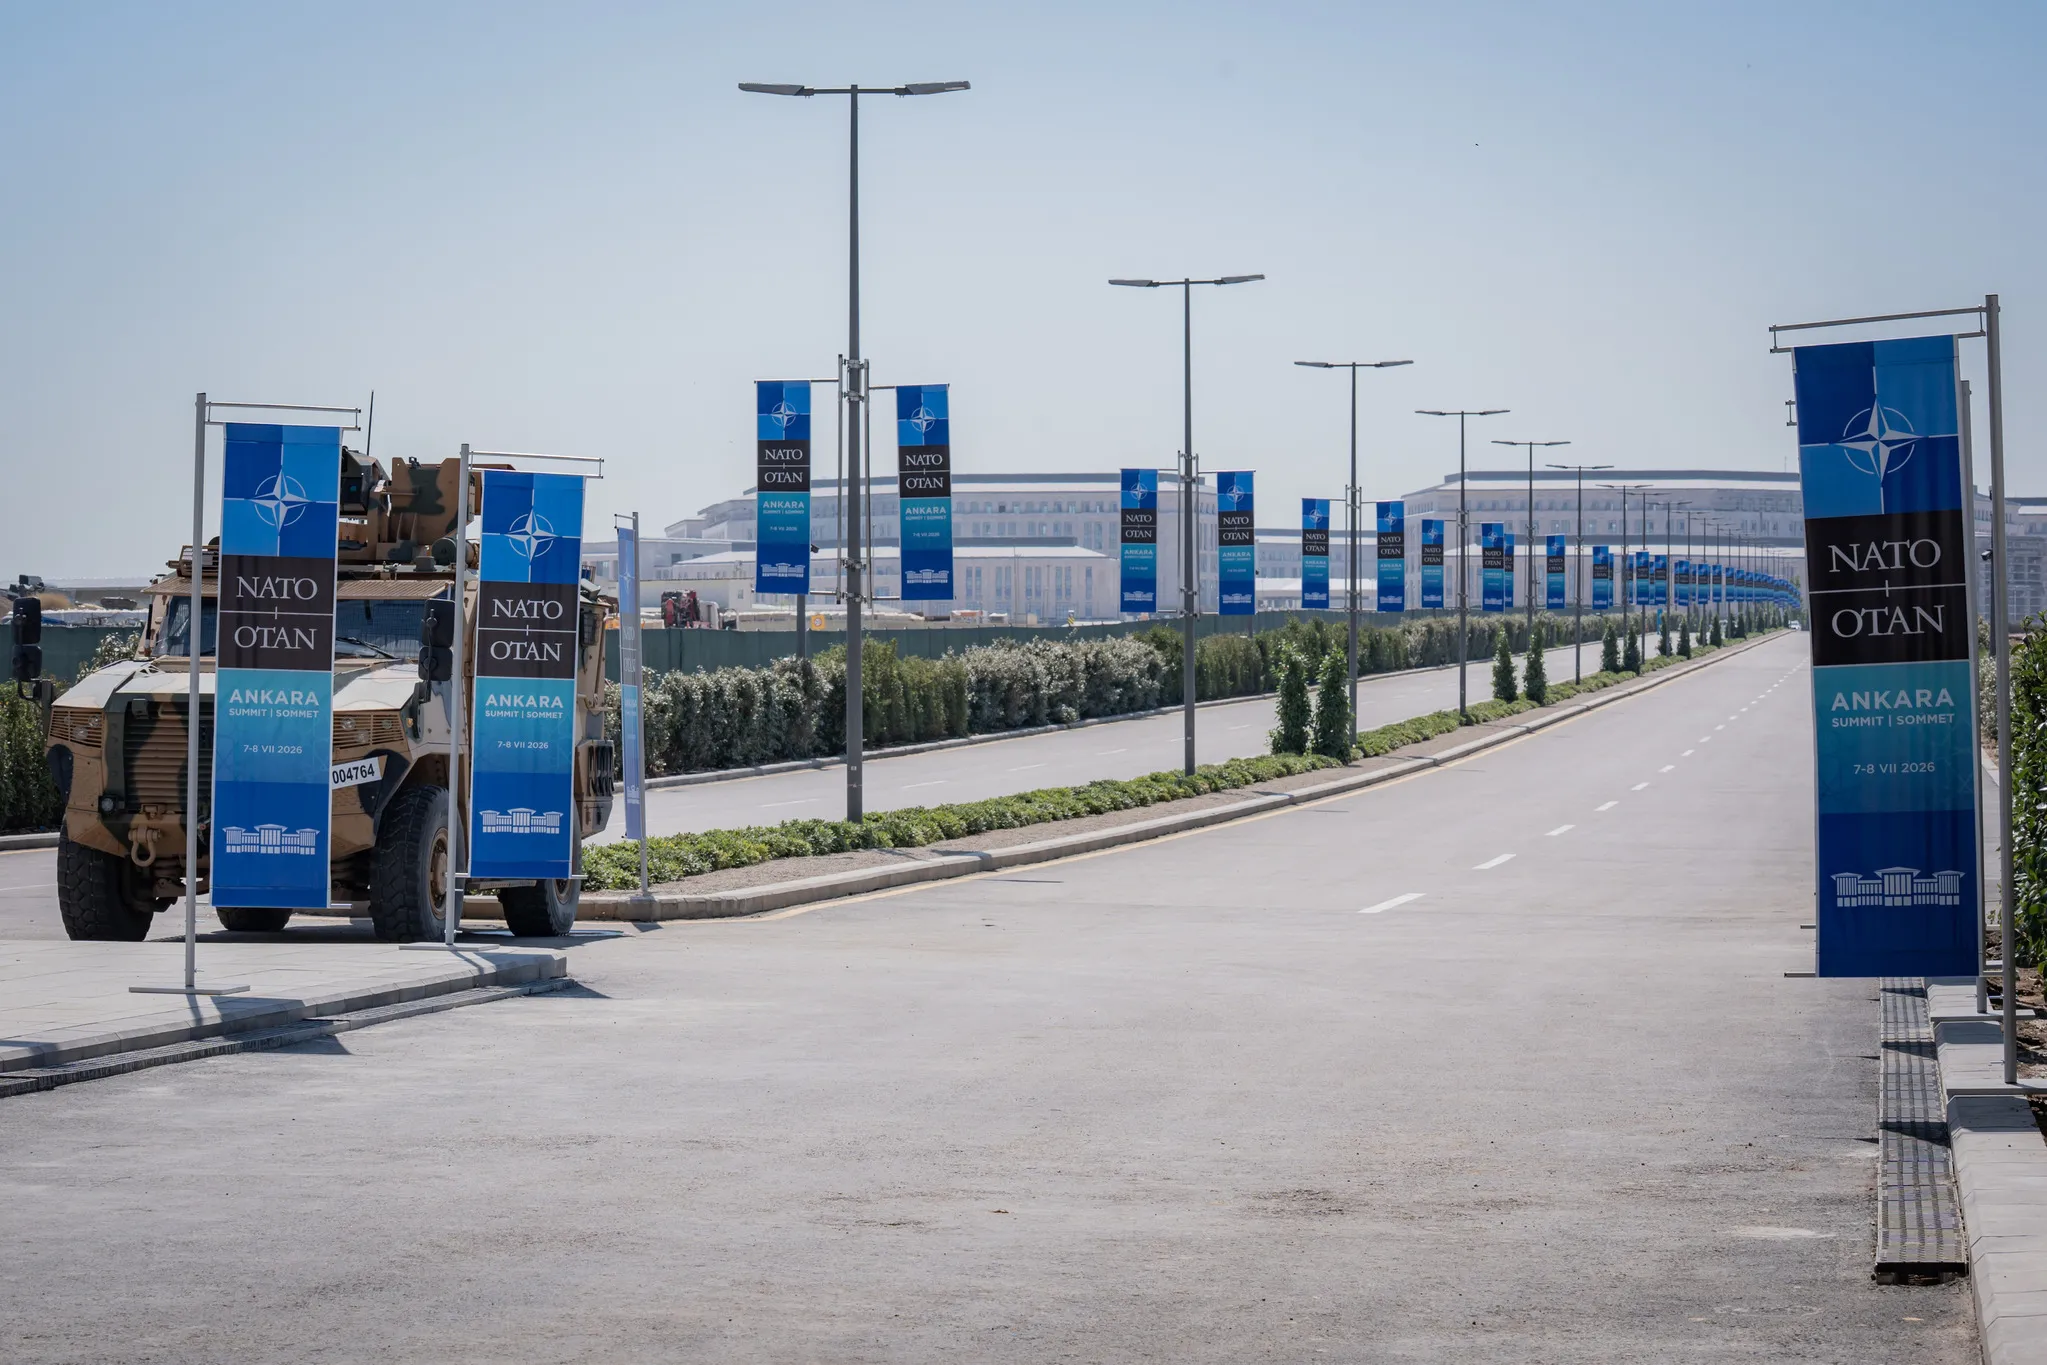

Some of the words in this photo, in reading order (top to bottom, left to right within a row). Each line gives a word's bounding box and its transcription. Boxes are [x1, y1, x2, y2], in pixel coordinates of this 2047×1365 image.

[765, 449, 803, 460] NATO
[905, 454, 943, 465] NATO
[764, 472, 803, 483] OTAN
[906, 477, 944, 489] OTAN
[905, 506, 947, 515] ANKARA
[1126, 514, 1152, 522] NATO
[1223, 516, 1249, 524] NATO
[1125, 530, 1152, 538] OTAN
[1222, 532, 1249, 540] OTAN
[1827, 538, 1942, 573] NATO
[236, 576, 318, 600] NATO
[491, 598, 563, 620] NATO
[1831, 604, 1945, 638] OTAN
[234, 625, 318, 650] OTAN
[490, 640, 563, 662] OTAN
[229, 689, 319, 706] ANKARA
[485, 694, 564, 709] ANKARA
[1831, 688, 1955, 711] ANKARA
[229, 708, 267, 717] SUMMIT
[275, 709, 320, 718] SOMMET
[485, 710, 519, 718] SUMMIT
[526, 711, 564, 719] SOMMET
[1831, 716, 1884, 728] SUMMIT
[1896, 713, 1955, 725] SOMMET
[243, 744, 258, 753] 7-8
[261, 745, 275, 753] VII
[275, 745, 303, 754] 2026
[527, 741, 549, 749] 2026
[332, 763, 375, 784] 004764
[1853, 763, 1875, 775] 7-8
[1879, 763, 1897, 774] VII
[1901, 762, 1936, 774] 2026
